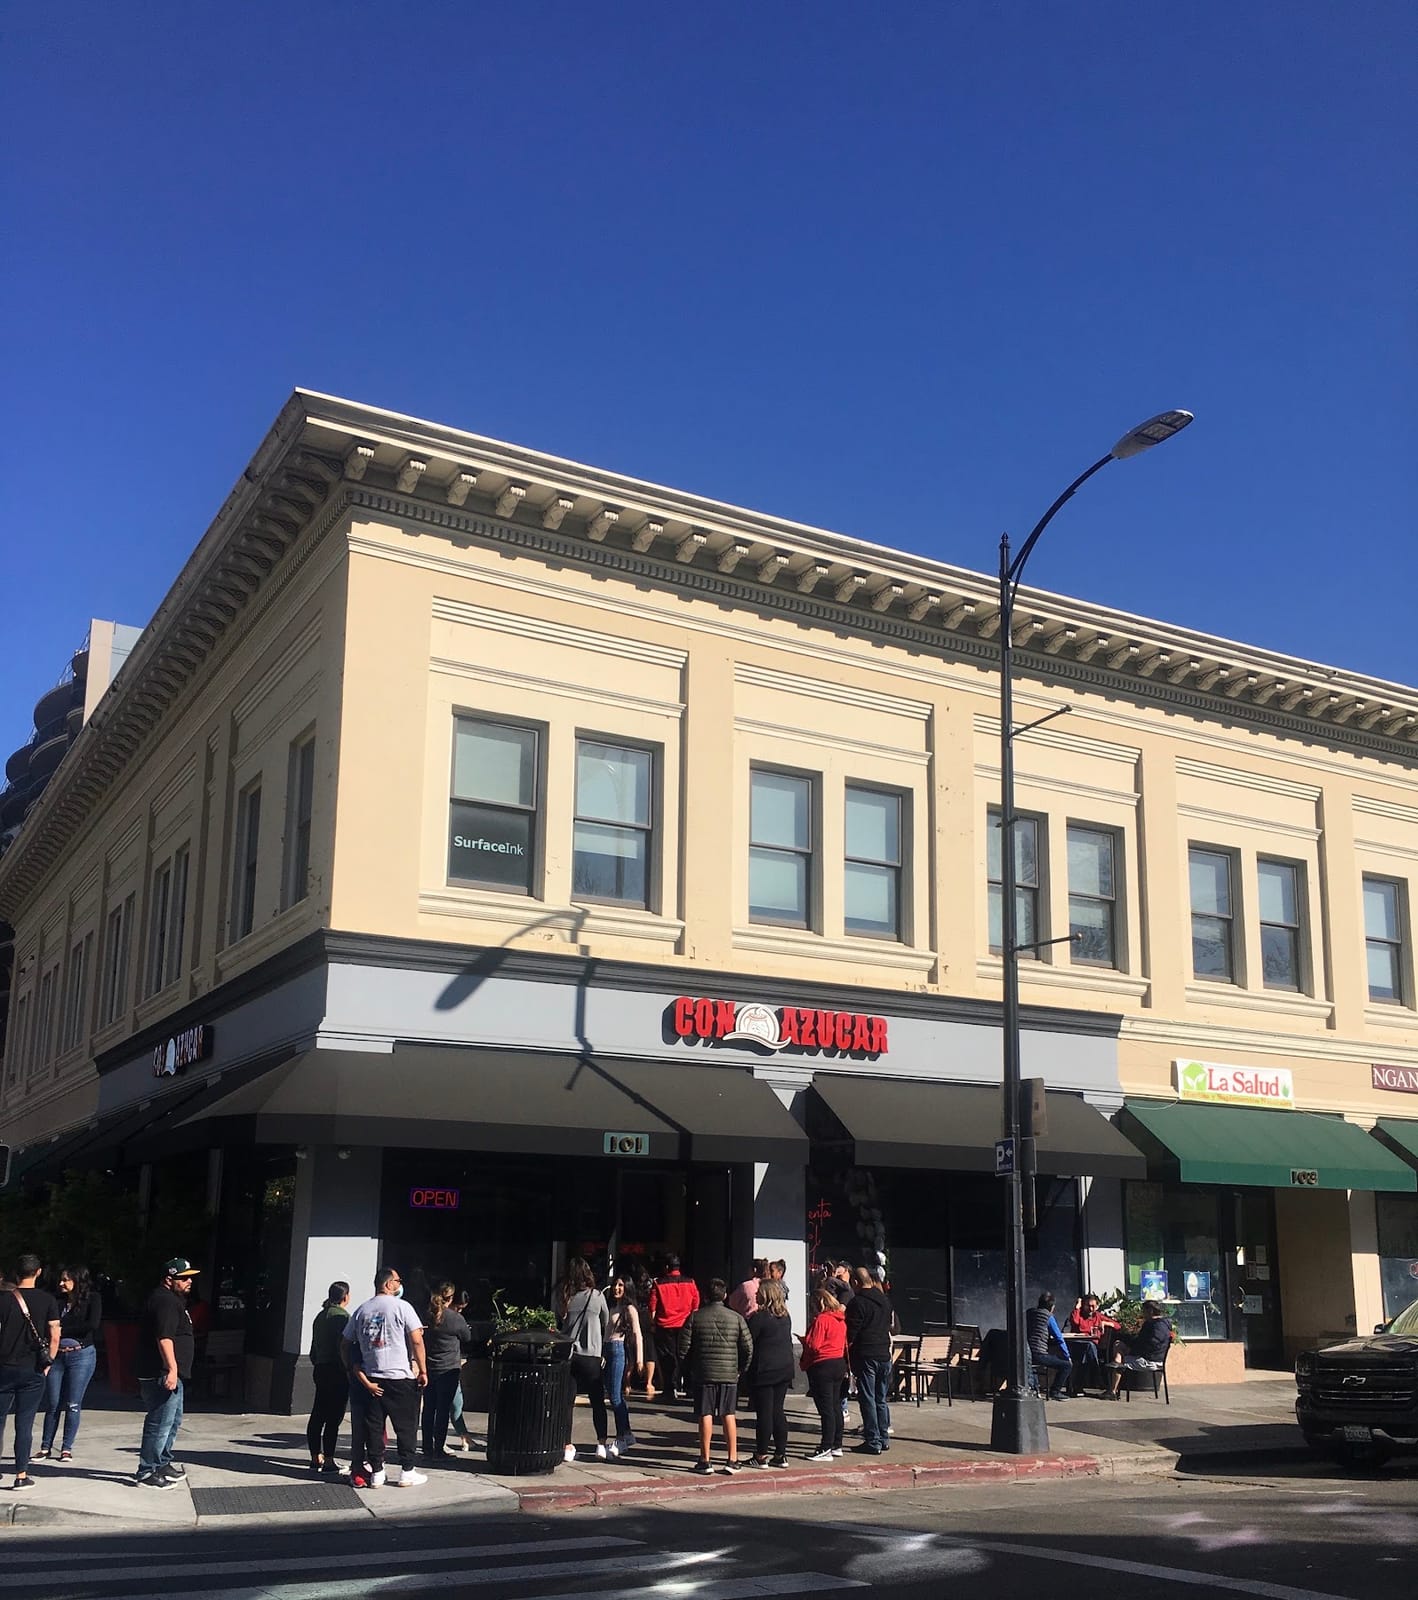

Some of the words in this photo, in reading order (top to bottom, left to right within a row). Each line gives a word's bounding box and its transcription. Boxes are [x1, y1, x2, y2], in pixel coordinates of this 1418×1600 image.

[454, 835, 524, 856] SurfaceInk
[675, 996, 736, 1039] CON
[780, 1005, 889, 1054] AZUCAR
[1207, 1068, 1230, 1092] La
[1232, 1071, 1280, 1097] Salud
[609, 1135, 643, 1154] 101
[412, 1190, 457, 1206] OPEN
